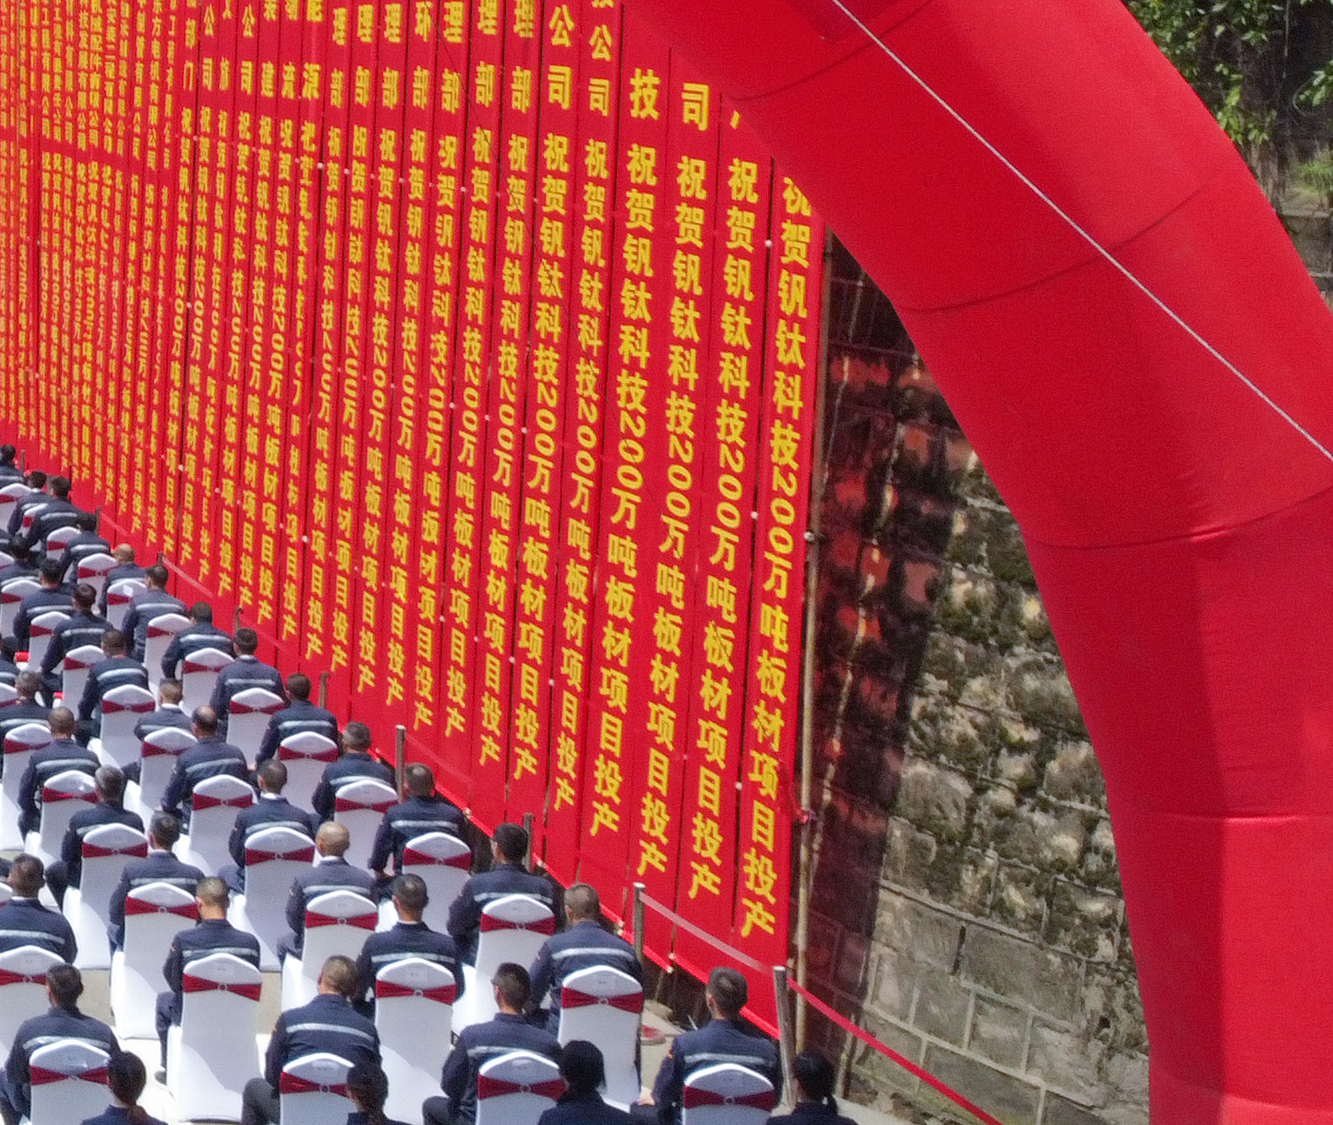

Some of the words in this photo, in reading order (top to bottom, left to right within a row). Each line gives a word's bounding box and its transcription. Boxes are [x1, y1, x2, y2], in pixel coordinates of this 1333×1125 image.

[239, 117, 271, 607] 祝贺钒钛科技200万吨板材项目投产
[258, 120, 293, 623] 祝贺钒钛科技200万吨板材项目投产
[306, 127, 340, 659] 祝贺钒钛科技200万吨板材项目投产
[331, 125, 367, 671] 祝贺钒钛科技200万吨板材项目投产
[358, 129, 396, 692] 祝贺钒钛科技200万吨板材项目投产
[387, 129, 426, 705] 祝贺钒钛科技200万吨板材项目投产
[414, 136, 457, 729] 祝贺钒钛科技200万吨板材项目投产
[445, 127, 491, 736] 祝贺钒钛科技200万吨板材项目投产
[480, 134, 528, 764] 祝贺钒钛科技200万吨板材项目投产
[514, 133, 569, 779] 祝贺钒钛科技200万吨板材项目投产
[554, 139, 609, 810] 祝贺钒钛科技200万吨板材项目投产
[591, 144, 657, 835] 祝贺钒钛科技200万吨板材项目投产
[637, 156, 706, 875] 祝贺钒钛科技200万吨板材项目投产
[689, 158, 758, 898] 祝贺钒钛科技200万吨板材项目投产
